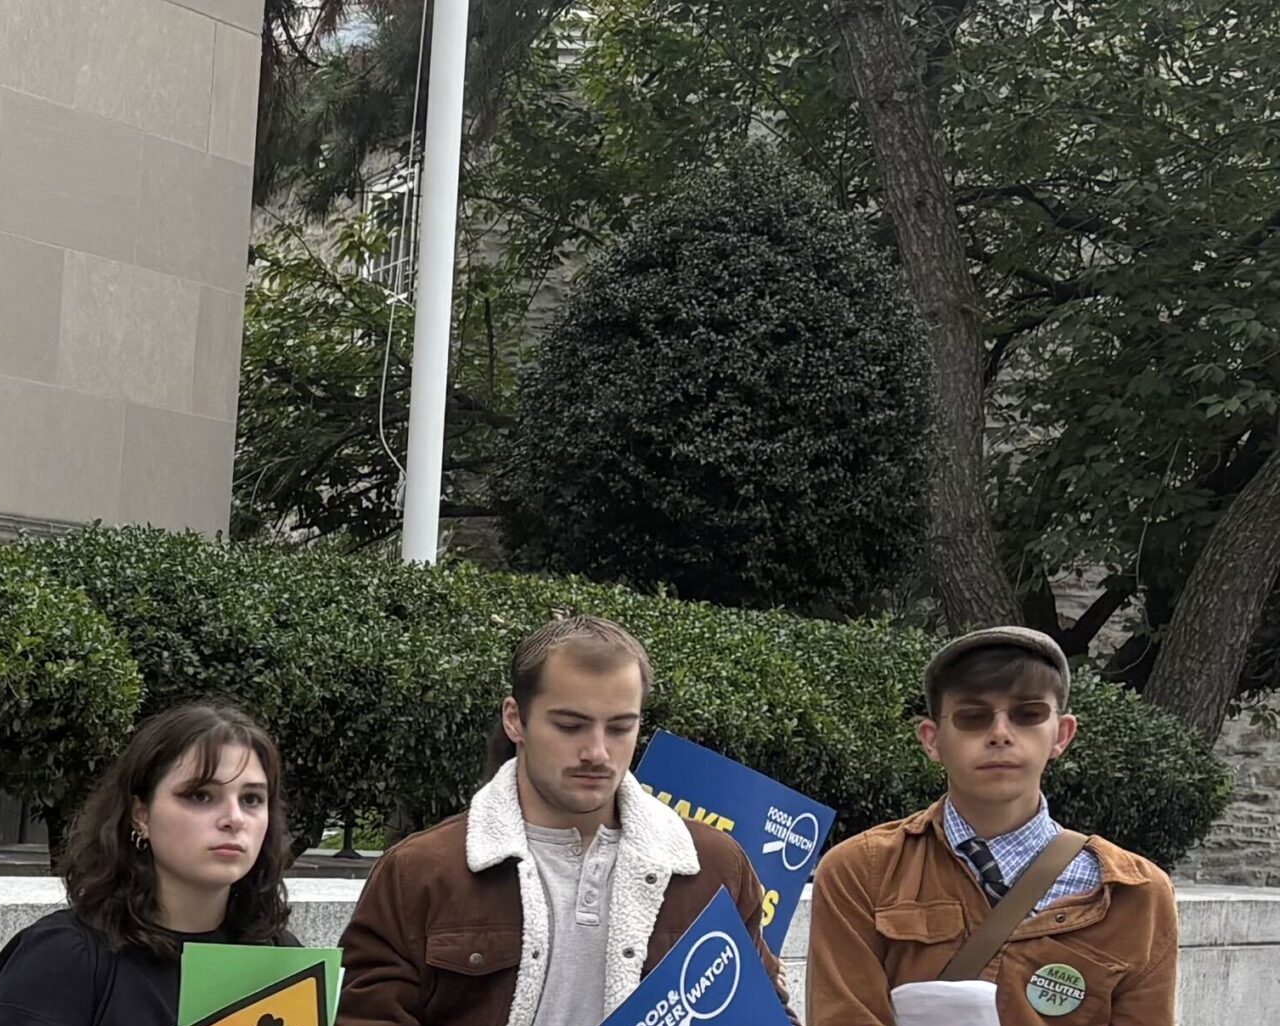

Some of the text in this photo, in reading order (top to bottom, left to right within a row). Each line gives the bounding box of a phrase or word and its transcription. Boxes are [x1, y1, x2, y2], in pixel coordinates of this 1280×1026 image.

[686, 945, 734, 1004] WATCH
[1047, 968, 1082, 986] MAKE
[1030, 975, 1085, 1000] POLLUTERS
[1038, 989, 1069, 1006] PAY
